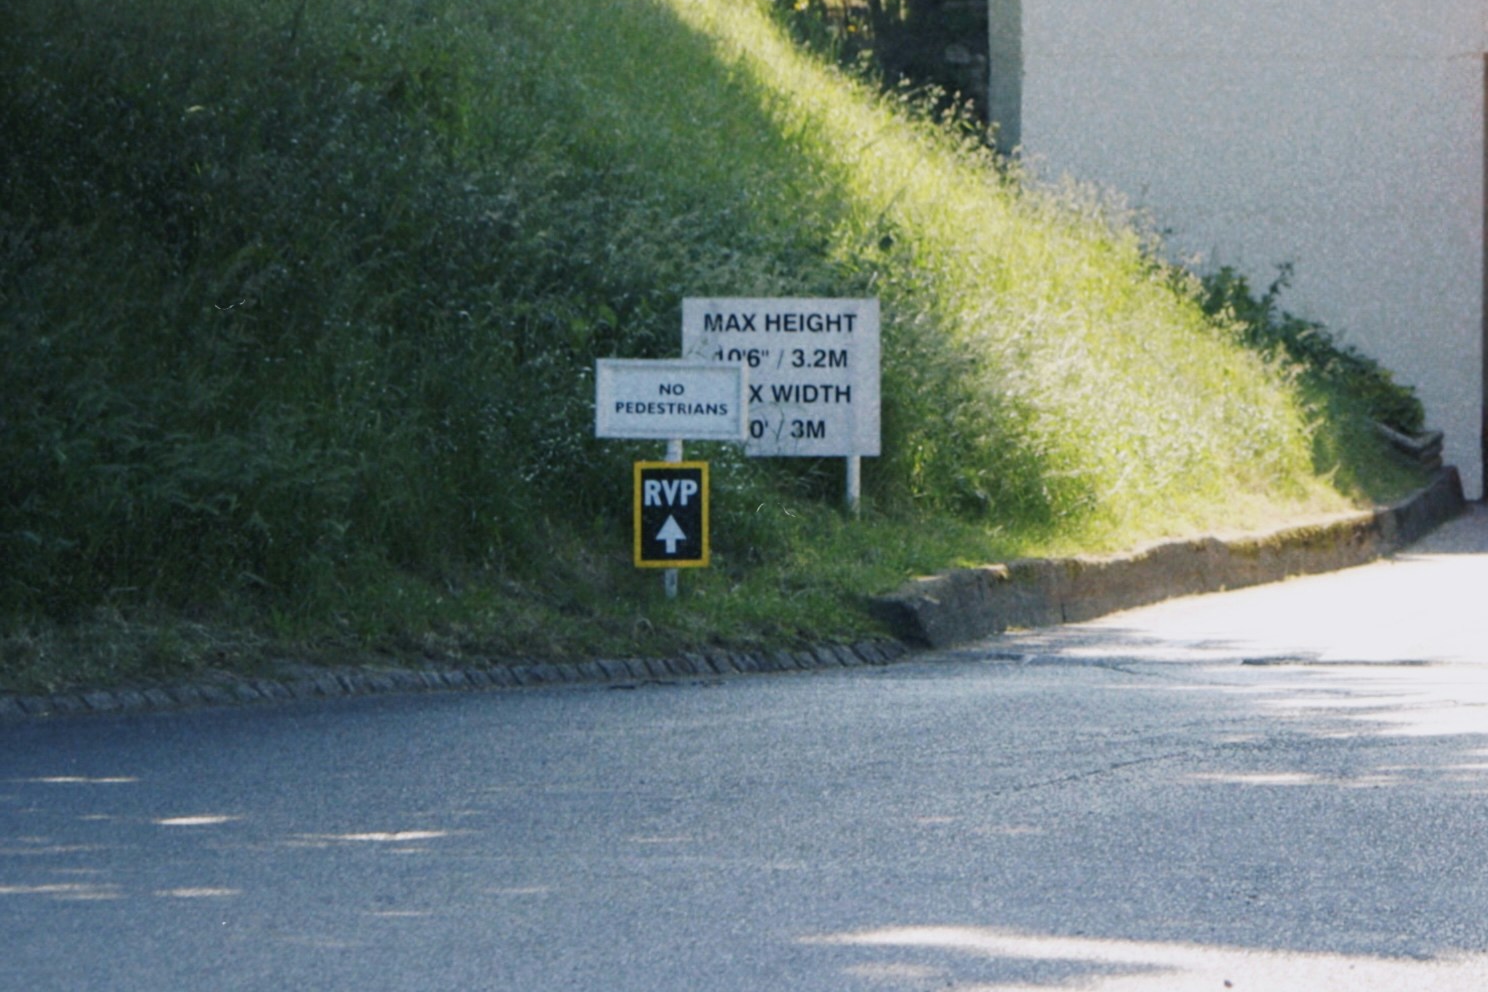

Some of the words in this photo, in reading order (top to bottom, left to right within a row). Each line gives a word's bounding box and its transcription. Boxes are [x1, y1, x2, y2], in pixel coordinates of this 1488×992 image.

[703, 314, 756, 333] MAX
[765, 313, 858, 333] HEIGHT
[791, 348, 848, 368] 3.2M
[658, 383, 685, 396] NO
[771, 384, 852, 403] WIDTH
[614, 401, 729, 416] PEDESTRIANS
[790, 419, 825, 439] 3M
[644, 479, 698, 506] RVP
